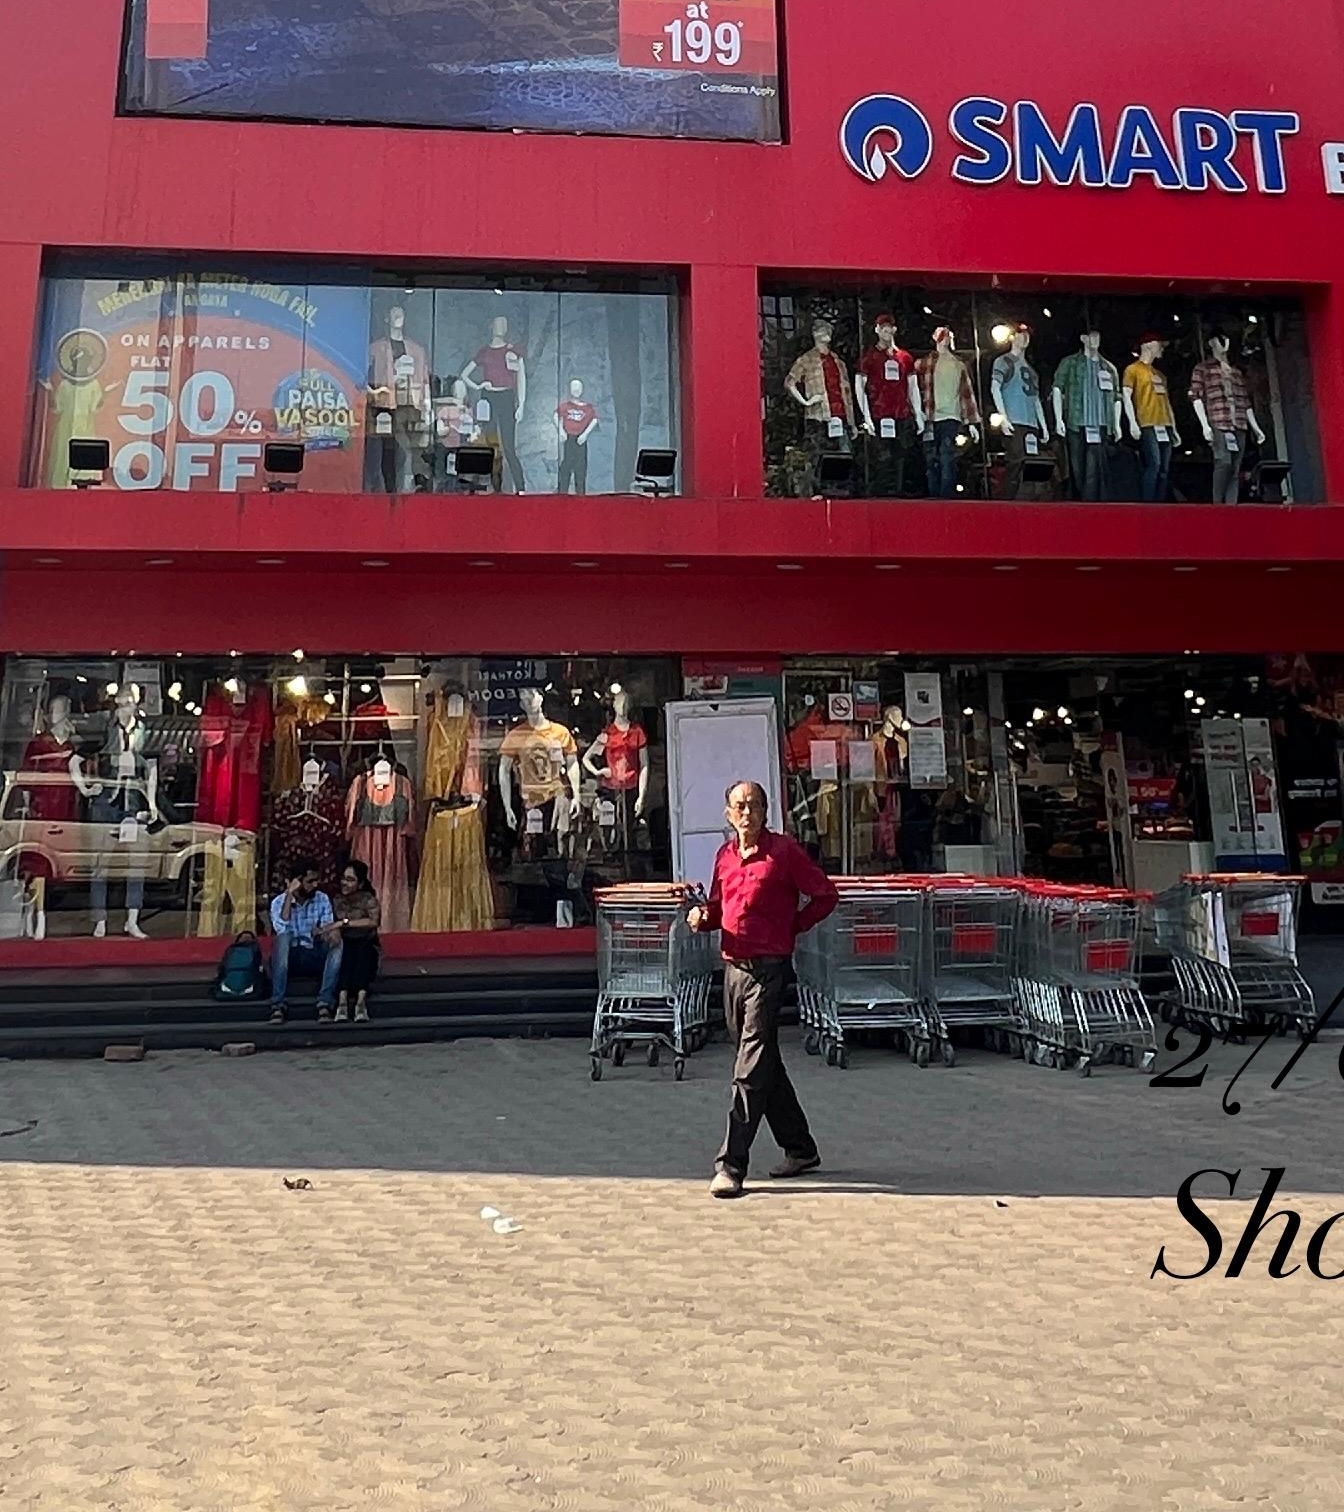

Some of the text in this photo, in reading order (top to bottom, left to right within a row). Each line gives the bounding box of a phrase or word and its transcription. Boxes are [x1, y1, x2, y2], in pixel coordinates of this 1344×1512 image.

[686, 1, 709, 19] at
[749, 86, 776, 97] Apply
[949, 95, 1300, 195] SMART
[120, 334, 271, 351] ON APPARELS
[130, 354, 172, 369] FLAT
[288, 389, 349, 410] PAISA
[274, 407, 361, 427] VASOOL
[112, 440, 262, 492] OFF
